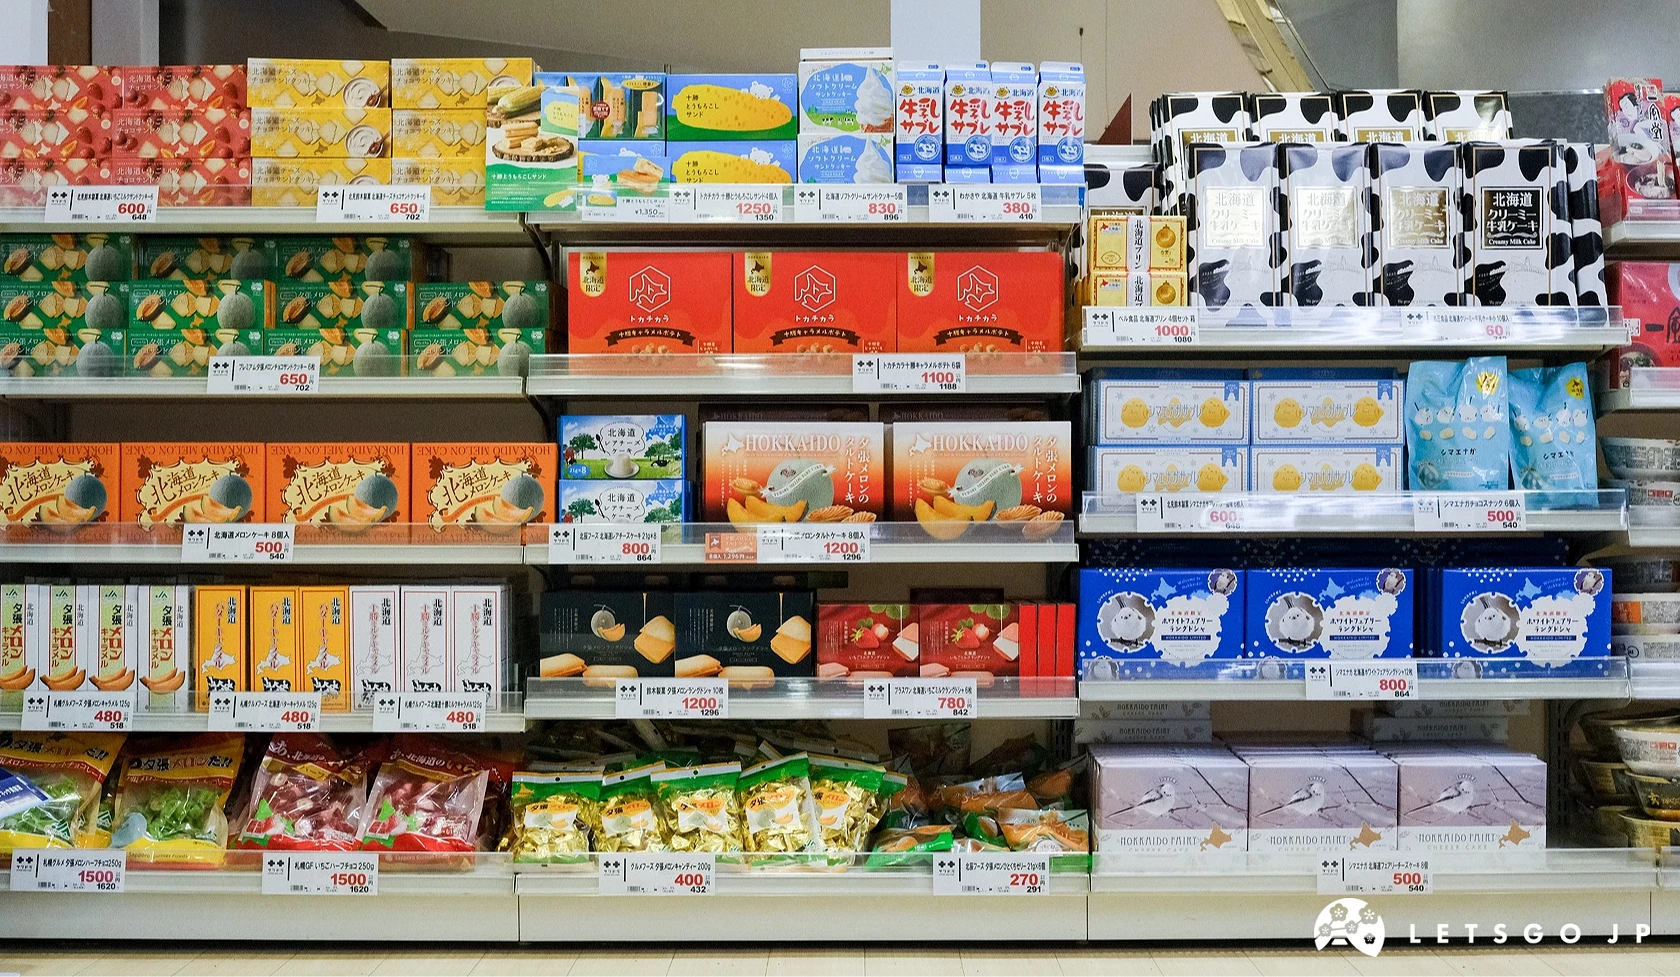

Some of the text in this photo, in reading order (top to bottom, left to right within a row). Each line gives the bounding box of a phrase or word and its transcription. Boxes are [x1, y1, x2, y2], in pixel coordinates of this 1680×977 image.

[813, 73, 840, 82] 北海道
[900, 98, 940, 118] 牛乳
[950, 98, 990, 119] 牛乳
[994, 100, 1034, 121] 牛乳
[1043, 100, 1083, 121] 牛乳
[900, 120, 940, 134] サブレ
[951, 119, 990, 134] サブレ
[995, 122, 1034, 136] サブレ
[1043, 121, 1082, 136] サブレ
[982, 192, 998, 200] 北海道
[1215, 193, 1255, 207] 北海道
[1398, 192, 1439, 206] 北海道
[1493, 193, 1532, 207] 北海道
[118, 203, 146, 215] 600
[390, 203, 419, 215] 650
[736, 203, 772, 215] 1250
[869, 203, 897, 215] 830
[1003, 203, 1031, 215] 380
[1488, 209, 1536, 220] クリーミー
[1486, 220, 1538, 232] 牛乳ケーキ
[630, 315, 670, 323] トカチカラ
[1155, 325, 1189, 337] 1000
[280, 374, 308, 385] 650
[922, 372, 955, 384] 1100
[1149, 405, 1201, 418] シマエナガサブレ
[1302, 405, 1355, 418] シマエナガサブレ
[608, 428, 635, 437] 北海道
[746, 434, 841, 452] HOKKAIDO
[933, 435, 1028, 451] HOKKAIDO
[126, 446, 258, 454] HOKKAIDO MELON CAKE
[845, 437, 855, 504] タルトケーキ
[858, 437, 869, 504] 夕張メロンの
[9, 467, 51, 504] 北海道
[33, 472, 74, 498] メロンケーキ
[152, 466, 197, 505] 北海道
[179, 470, 219, 497] メロンケーキ
[298, 466, 342, 506] 北海道
[444, 466, 488, 505] 北海道
[1210, 511, 1236, 522] 600
[1488, 511, 1515, 523] 500
[255, 542, 283, 554] 500
[622, 543, 649, 555] 800
[824, 542, 859, 555] 1200
[228, 597, 236, 624] 北海道
[332, 597, 340, 625] 北海道
[382, 598, 391, 625] 北海道
[10, 603, 22, 660] 夕張メロン
[60, 604, 73, 660] 夕張メロン
[1380, 679, 1406, 691] 800
[682, 698, 717, 710] 1200
[938, 697, 965, 709] 780
[94, 711, 123, 723] 480
[281, 711, 309, 722] 480
[447, 712, 474, 723] 480
[1120, 837, 1168, 845] HOKKAIDO
[1419, 833, 1467, 842] HOKKAIDO
[359, 862, 374, 871] 250g
[698, 863, 711, 871] 200g
[78, 871, 113, 882] 1500
[331, 874, 366, 886] 1500
[675, 874, 703, 886] 400
[1010, 874, 1038, 885] 270
[1393, 873, 1421, 885] 500
